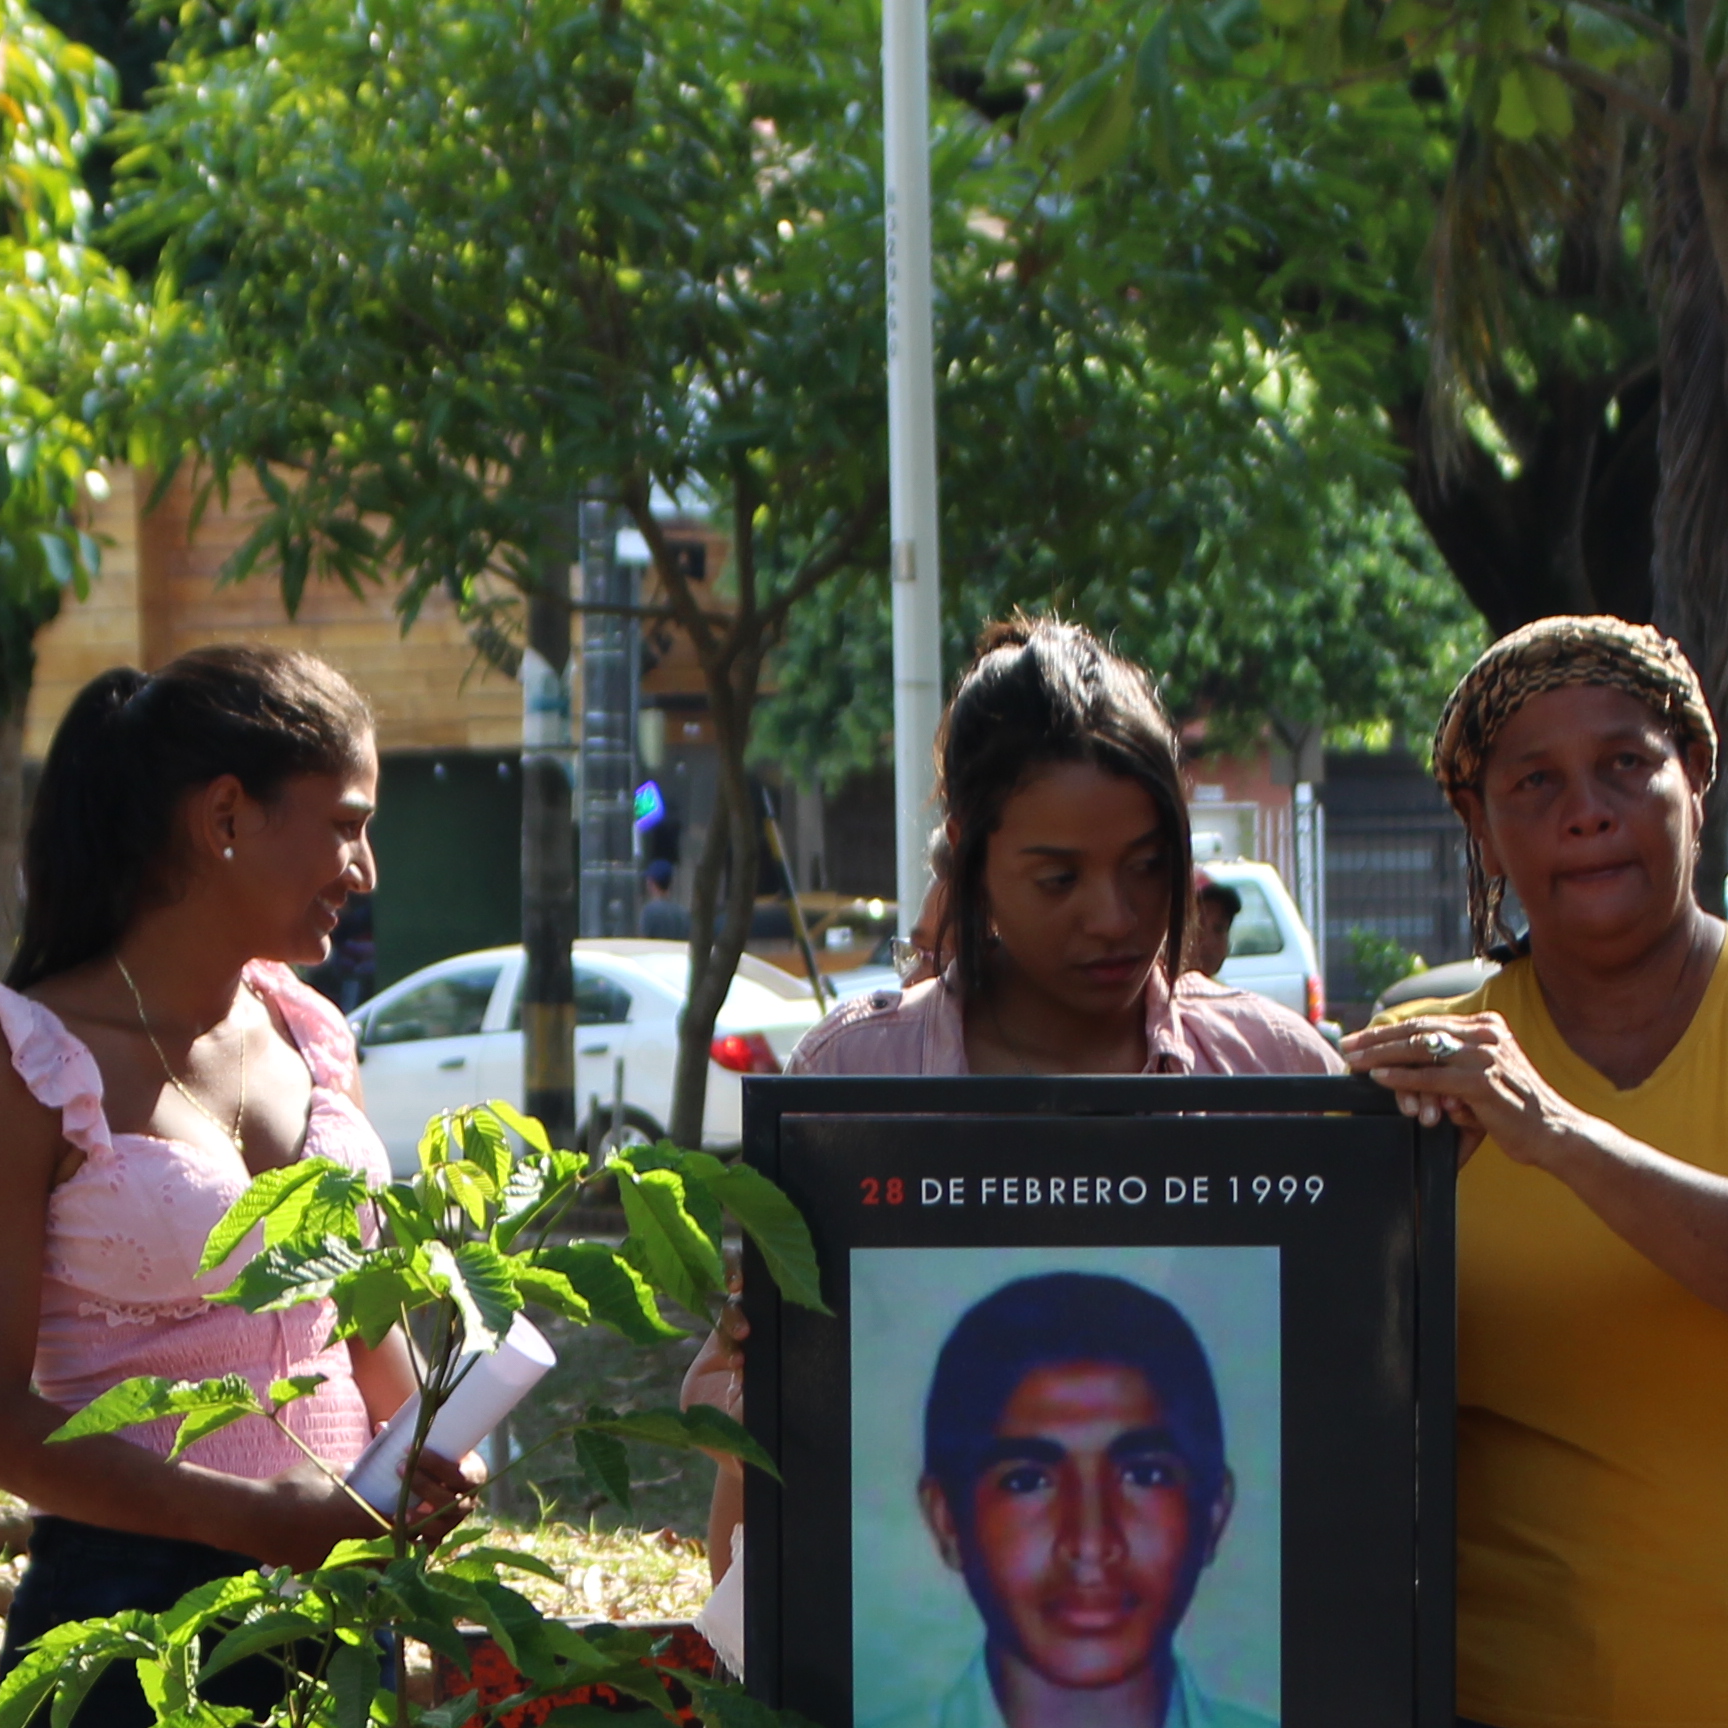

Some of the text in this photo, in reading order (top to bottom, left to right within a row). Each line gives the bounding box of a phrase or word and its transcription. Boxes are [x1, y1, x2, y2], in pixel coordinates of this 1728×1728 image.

[860, 1175, 1324, 1204] 28 DE FEBRERO DE 1999
